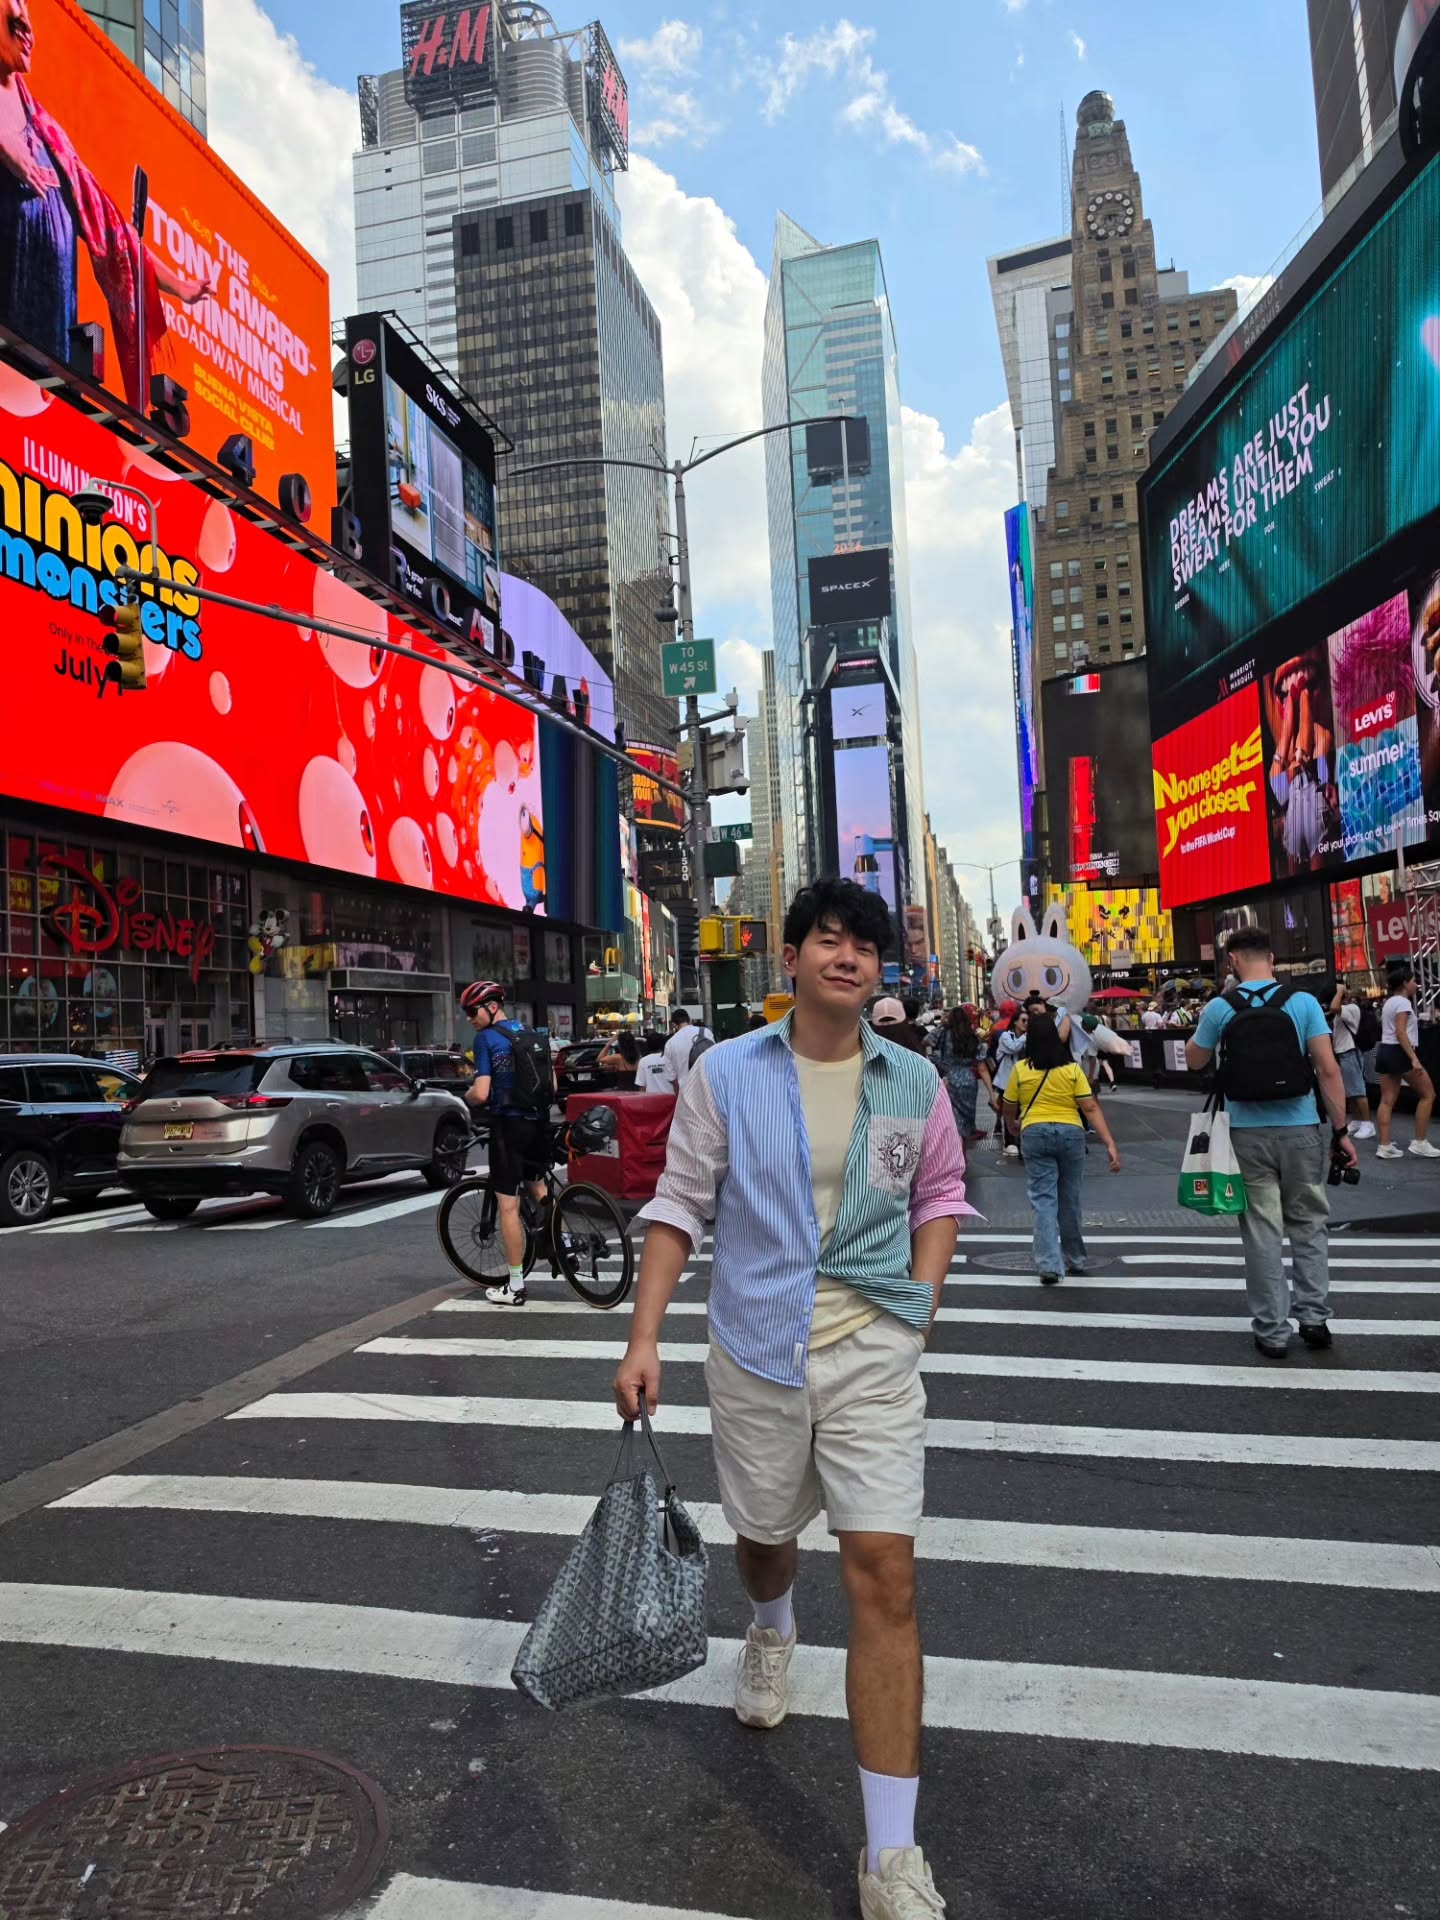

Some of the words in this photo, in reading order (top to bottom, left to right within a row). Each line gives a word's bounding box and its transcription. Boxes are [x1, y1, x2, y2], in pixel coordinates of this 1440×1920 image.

[410, 5, 490, 77] H&M
[148, 197, 222, 293] TONY
[214, 232, 250, 287] THE
[247, 370, 305, 436] MUSICAL
[354, 369, 375, 385] LG
[426, 384, 446, 417] SKS
[24, 436, 147, 532] ILLUMINION'S
[1170, 467, 1228, 544] DREAMS
[1233, 430, 1264, 485] ARE
[1269, 382, 1309, 448] JUST
[1171, 493, 1230, 569] DREAMS
[1233, 444, 1284, 508] UNTIL
[1287, 394, 1330, 456] YOU
[1174, 528, 1220, 592] SWEAT
[1225, 497, 1256, 546] FOR
[1260, 447, 1313, 512] THEM
[669, 664, 678, 674] W
[680, 661, 695, 673] 45
[681, 646, 694, 658] TO
[1153, 769, 1190, 810] No
[1188, 769, 1212, 796] one
[1210, 724, 1263, 791] gets
[720, 827, 728, 841] W
[731, 826, 742, 839] 46
[1163, 803, 1200, 859] you
[1199, 781, 1257, 819] closer
[1194, 834, 1208, 850] FIFA
[1223, 826, 1236, 839] Cup
[1318, 842, 1330, 853] Get
